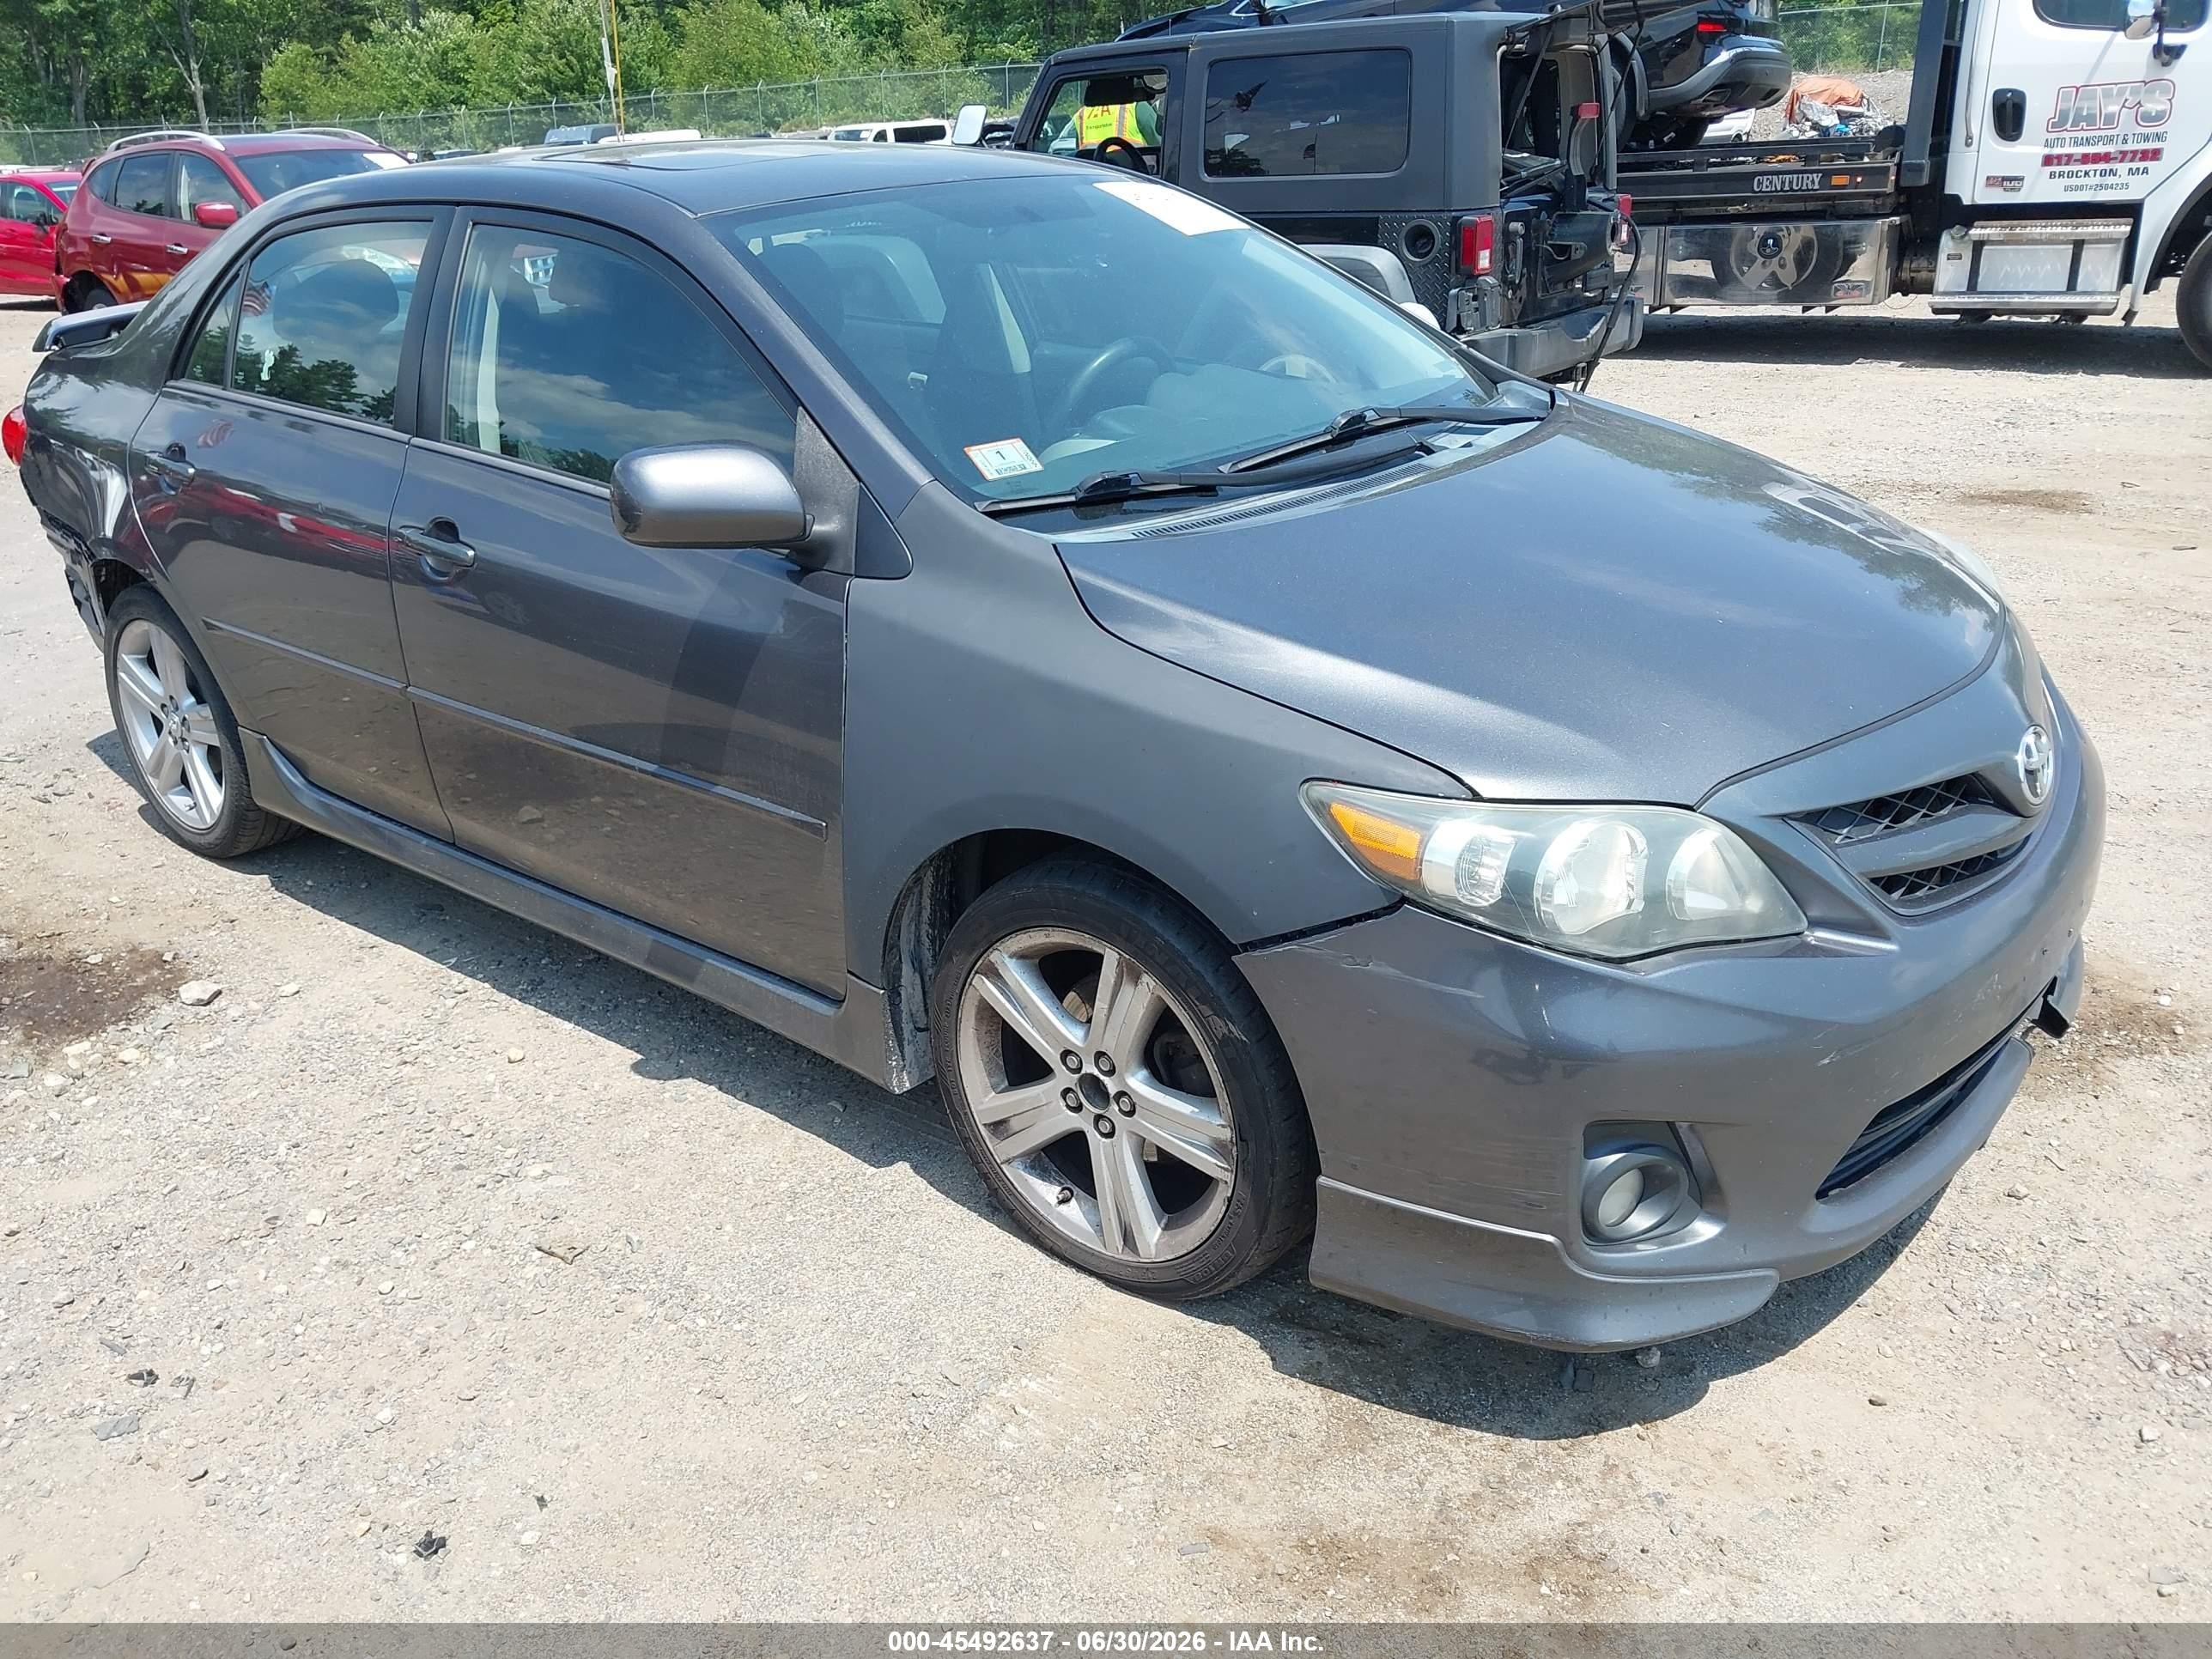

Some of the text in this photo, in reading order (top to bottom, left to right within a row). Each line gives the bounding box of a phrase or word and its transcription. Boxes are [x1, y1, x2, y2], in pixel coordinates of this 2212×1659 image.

[2046, 79, 2176, 132] JAY'S
[2044, 131, 2168, 149] AUTO TRANSPORT & TOWING
[1753, 173, 1823, 191] CENTURY
[2049, 167, 2149, 179] BROCKTON, MA
[2063, 182, 2130, 192] USDOT#2504235
